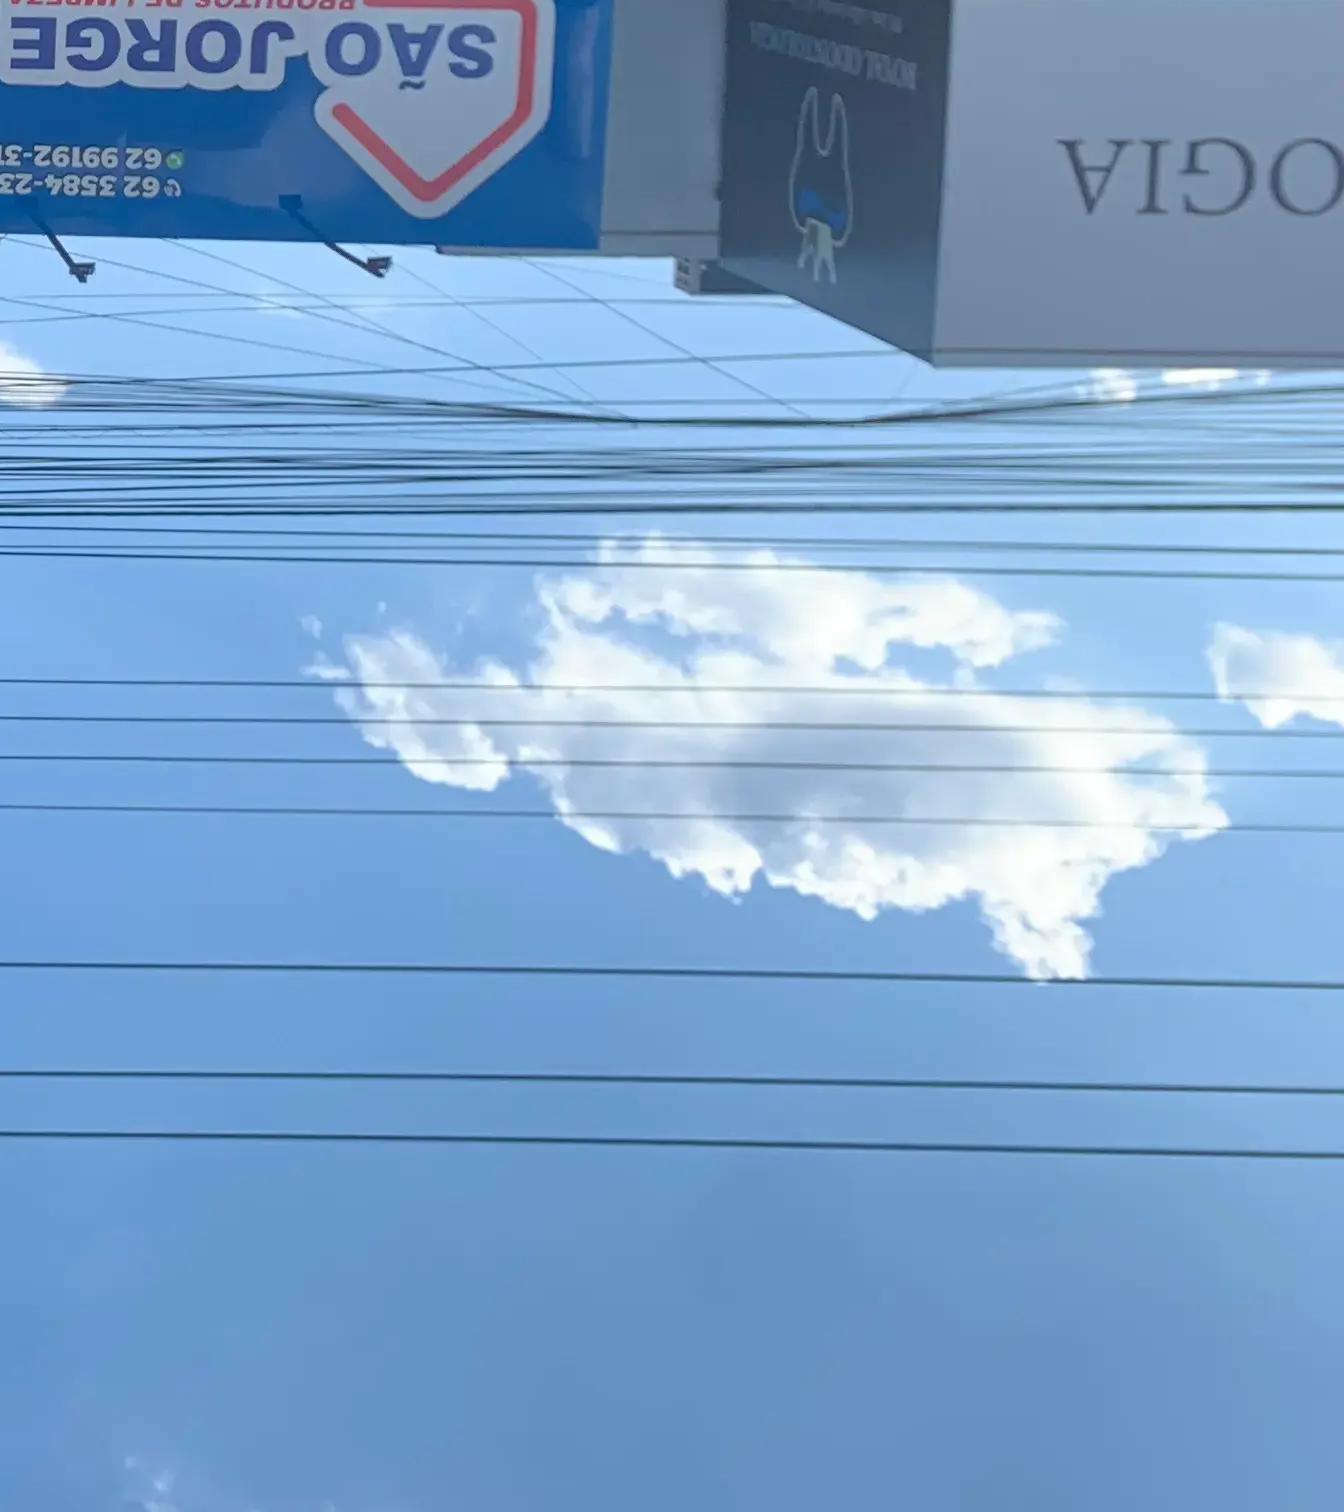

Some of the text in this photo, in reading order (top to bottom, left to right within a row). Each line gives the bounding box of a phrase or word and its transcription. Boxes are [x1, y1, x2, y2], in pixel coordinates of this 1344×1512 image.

[8, 16, 498, 91] SÃO JORGE
[125, 147, 162, 170] 62
[1055, 138, 1344, 217] OGIA
[123, 175, 160, 199] 62
